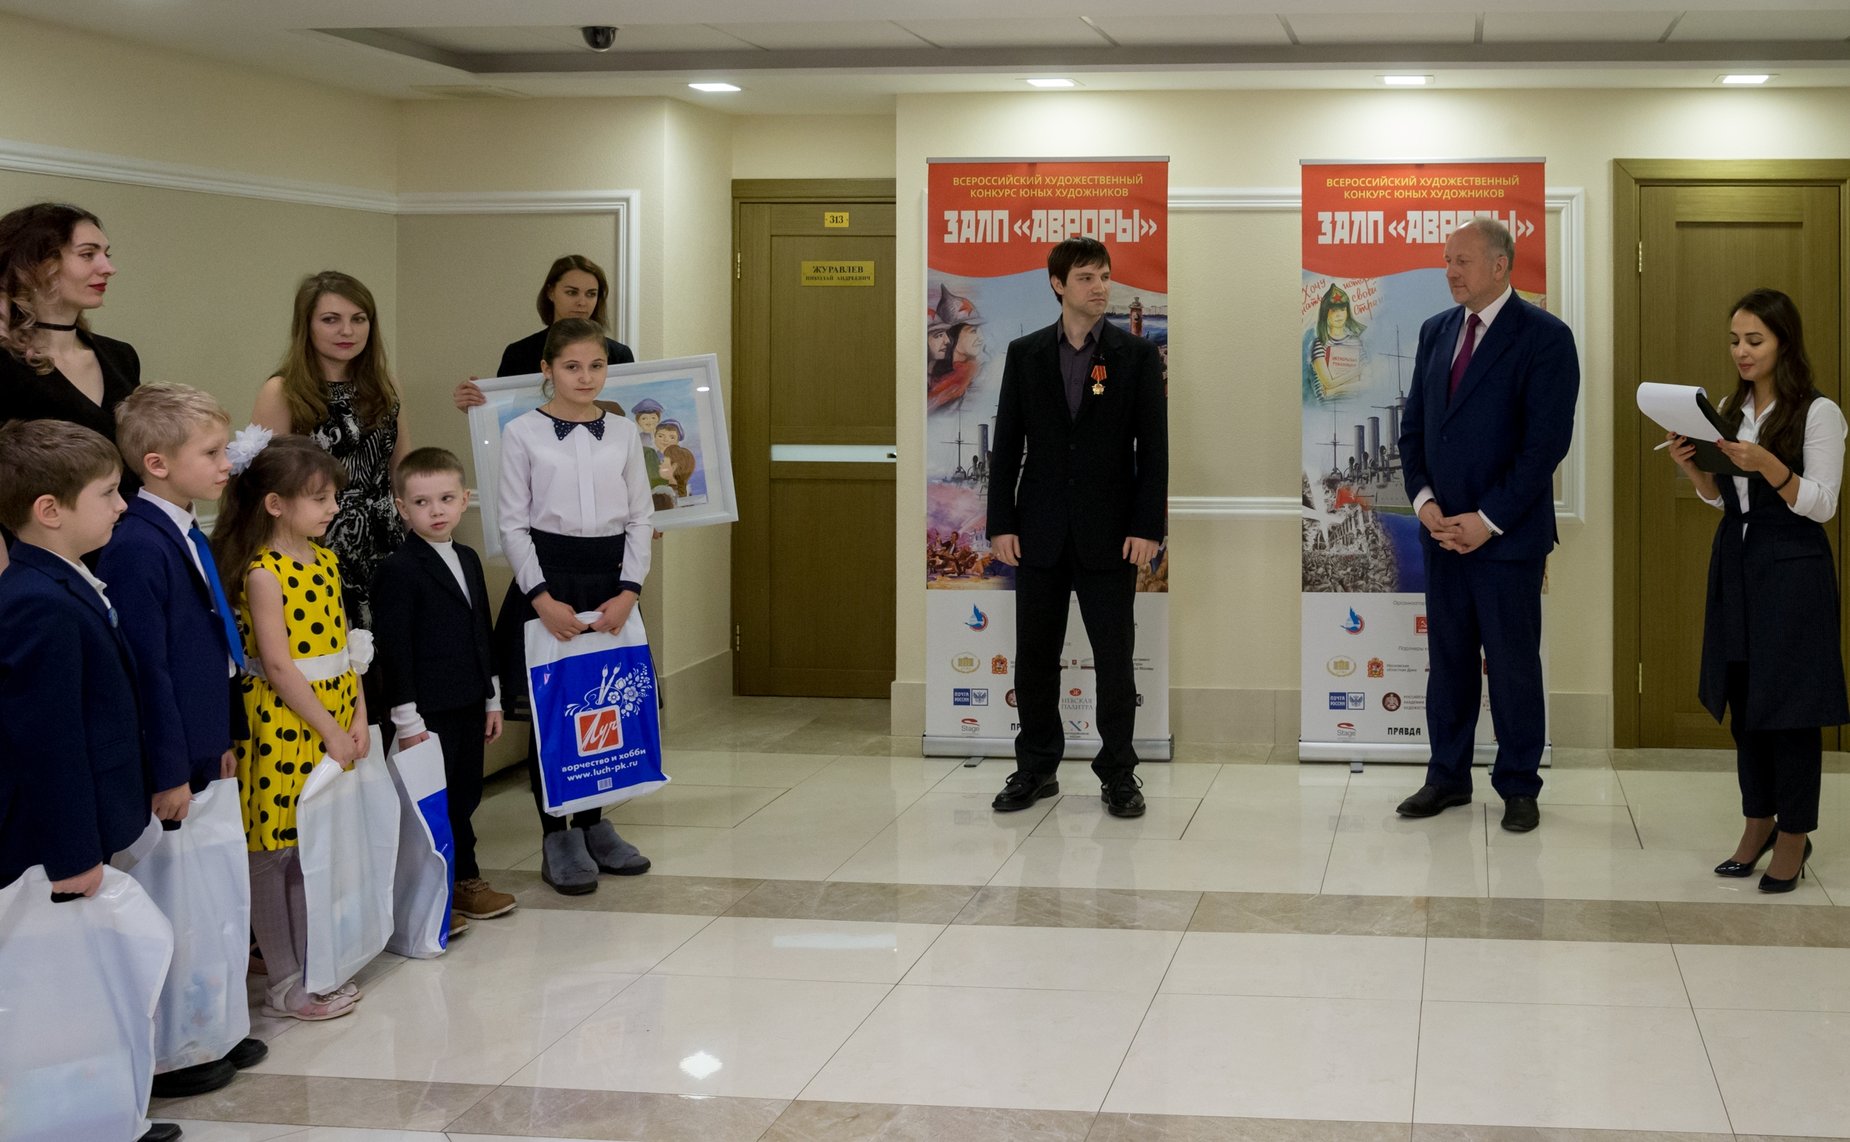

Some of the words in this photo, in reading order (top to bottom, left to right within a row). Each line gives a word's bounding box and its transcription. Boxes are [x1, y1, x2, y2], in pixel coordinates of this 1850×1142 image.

[953, 174, 1042, 186] ВСЕРОССИЙСКИЙ
[1044, 173, 1144, 187] ХУДОЖЕСТВЕННЫЙ
[1326, 175, 1417, 187] ВСЕРОССИЙСКИЙ
[1419, 174, 1520, 188] ХУДОЖЕСТВЕННЫЙ
[970, 188, 1017, 198] КОНКУРС
[1019, 188, 1052, 198] ЮНЫХ
[1055, 187, 1129, 199] ХУДОЖНИКОВ
[1343, 189, 1391, 199] КОНКУРС
[1394, 189, 1427, 199] ЮНЫХ
[1430, 188, 1505, 200] ХУДОЖНИКОВ
[829, 215, 844, 224] 313
[943, 209, 1009, 244] ЗАЛП
[1013, 209, 1158, 244] «АВРОРЫ»
[1317, 210, 1384, 244] ЗАЛП
[812, 265, 864, 274] ЖУРАВЛЕВ
[961, 725, 980, 733] Stage
[1336, 729, 1356, 738] Stage
[1387, 727, 1421, 736] ПРАВДА
[561, 757, 610, 773] ворчество
[619, 748, 646, 760] хобби
[567, 760, 638, 782] www.luch-pk.ru
